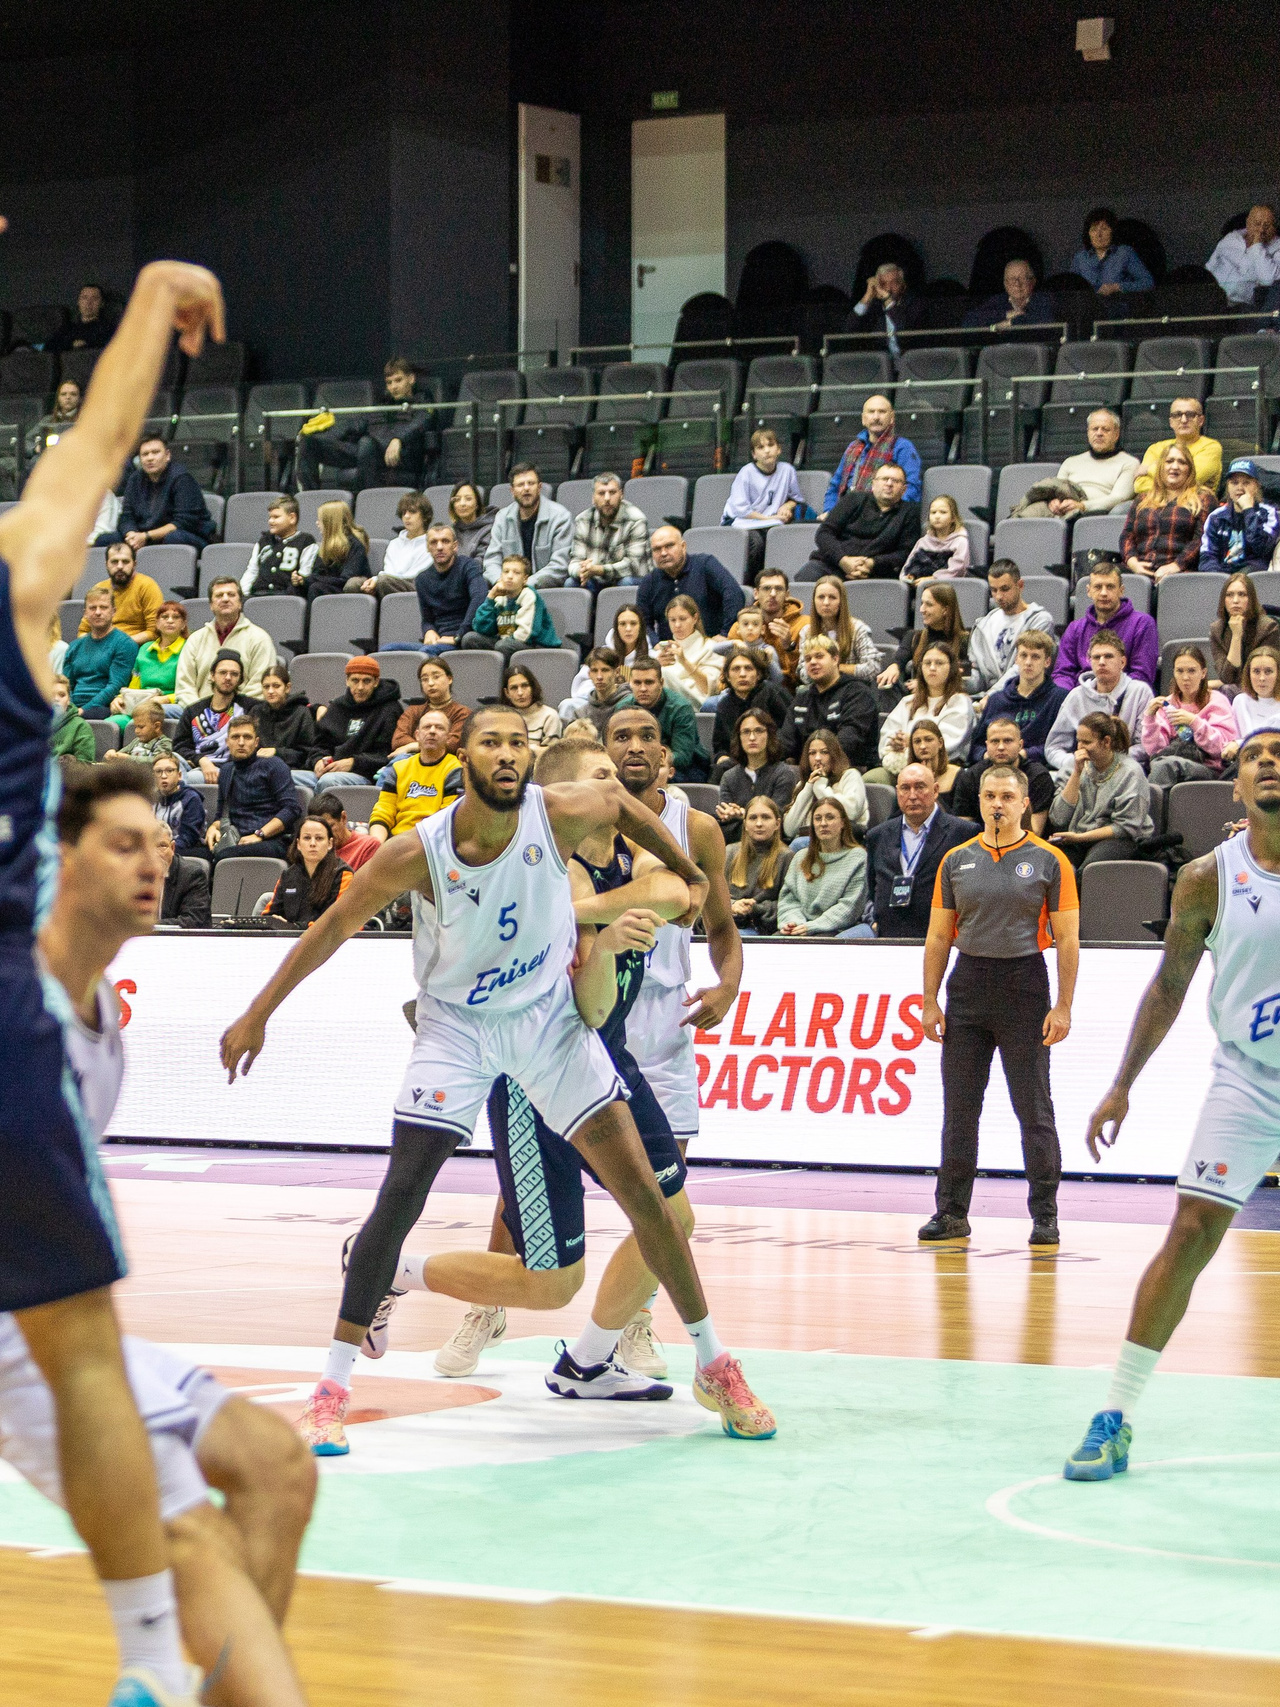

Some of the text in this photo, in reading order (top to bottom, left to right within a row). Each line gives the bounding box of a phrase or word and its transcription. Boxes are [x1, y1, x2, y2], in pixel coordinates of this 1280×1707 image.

[498, 901, 518, 942] 5
[694, 991, 926, 1051] LARUS
[695, 1053, 916, 1116] RACTORS
